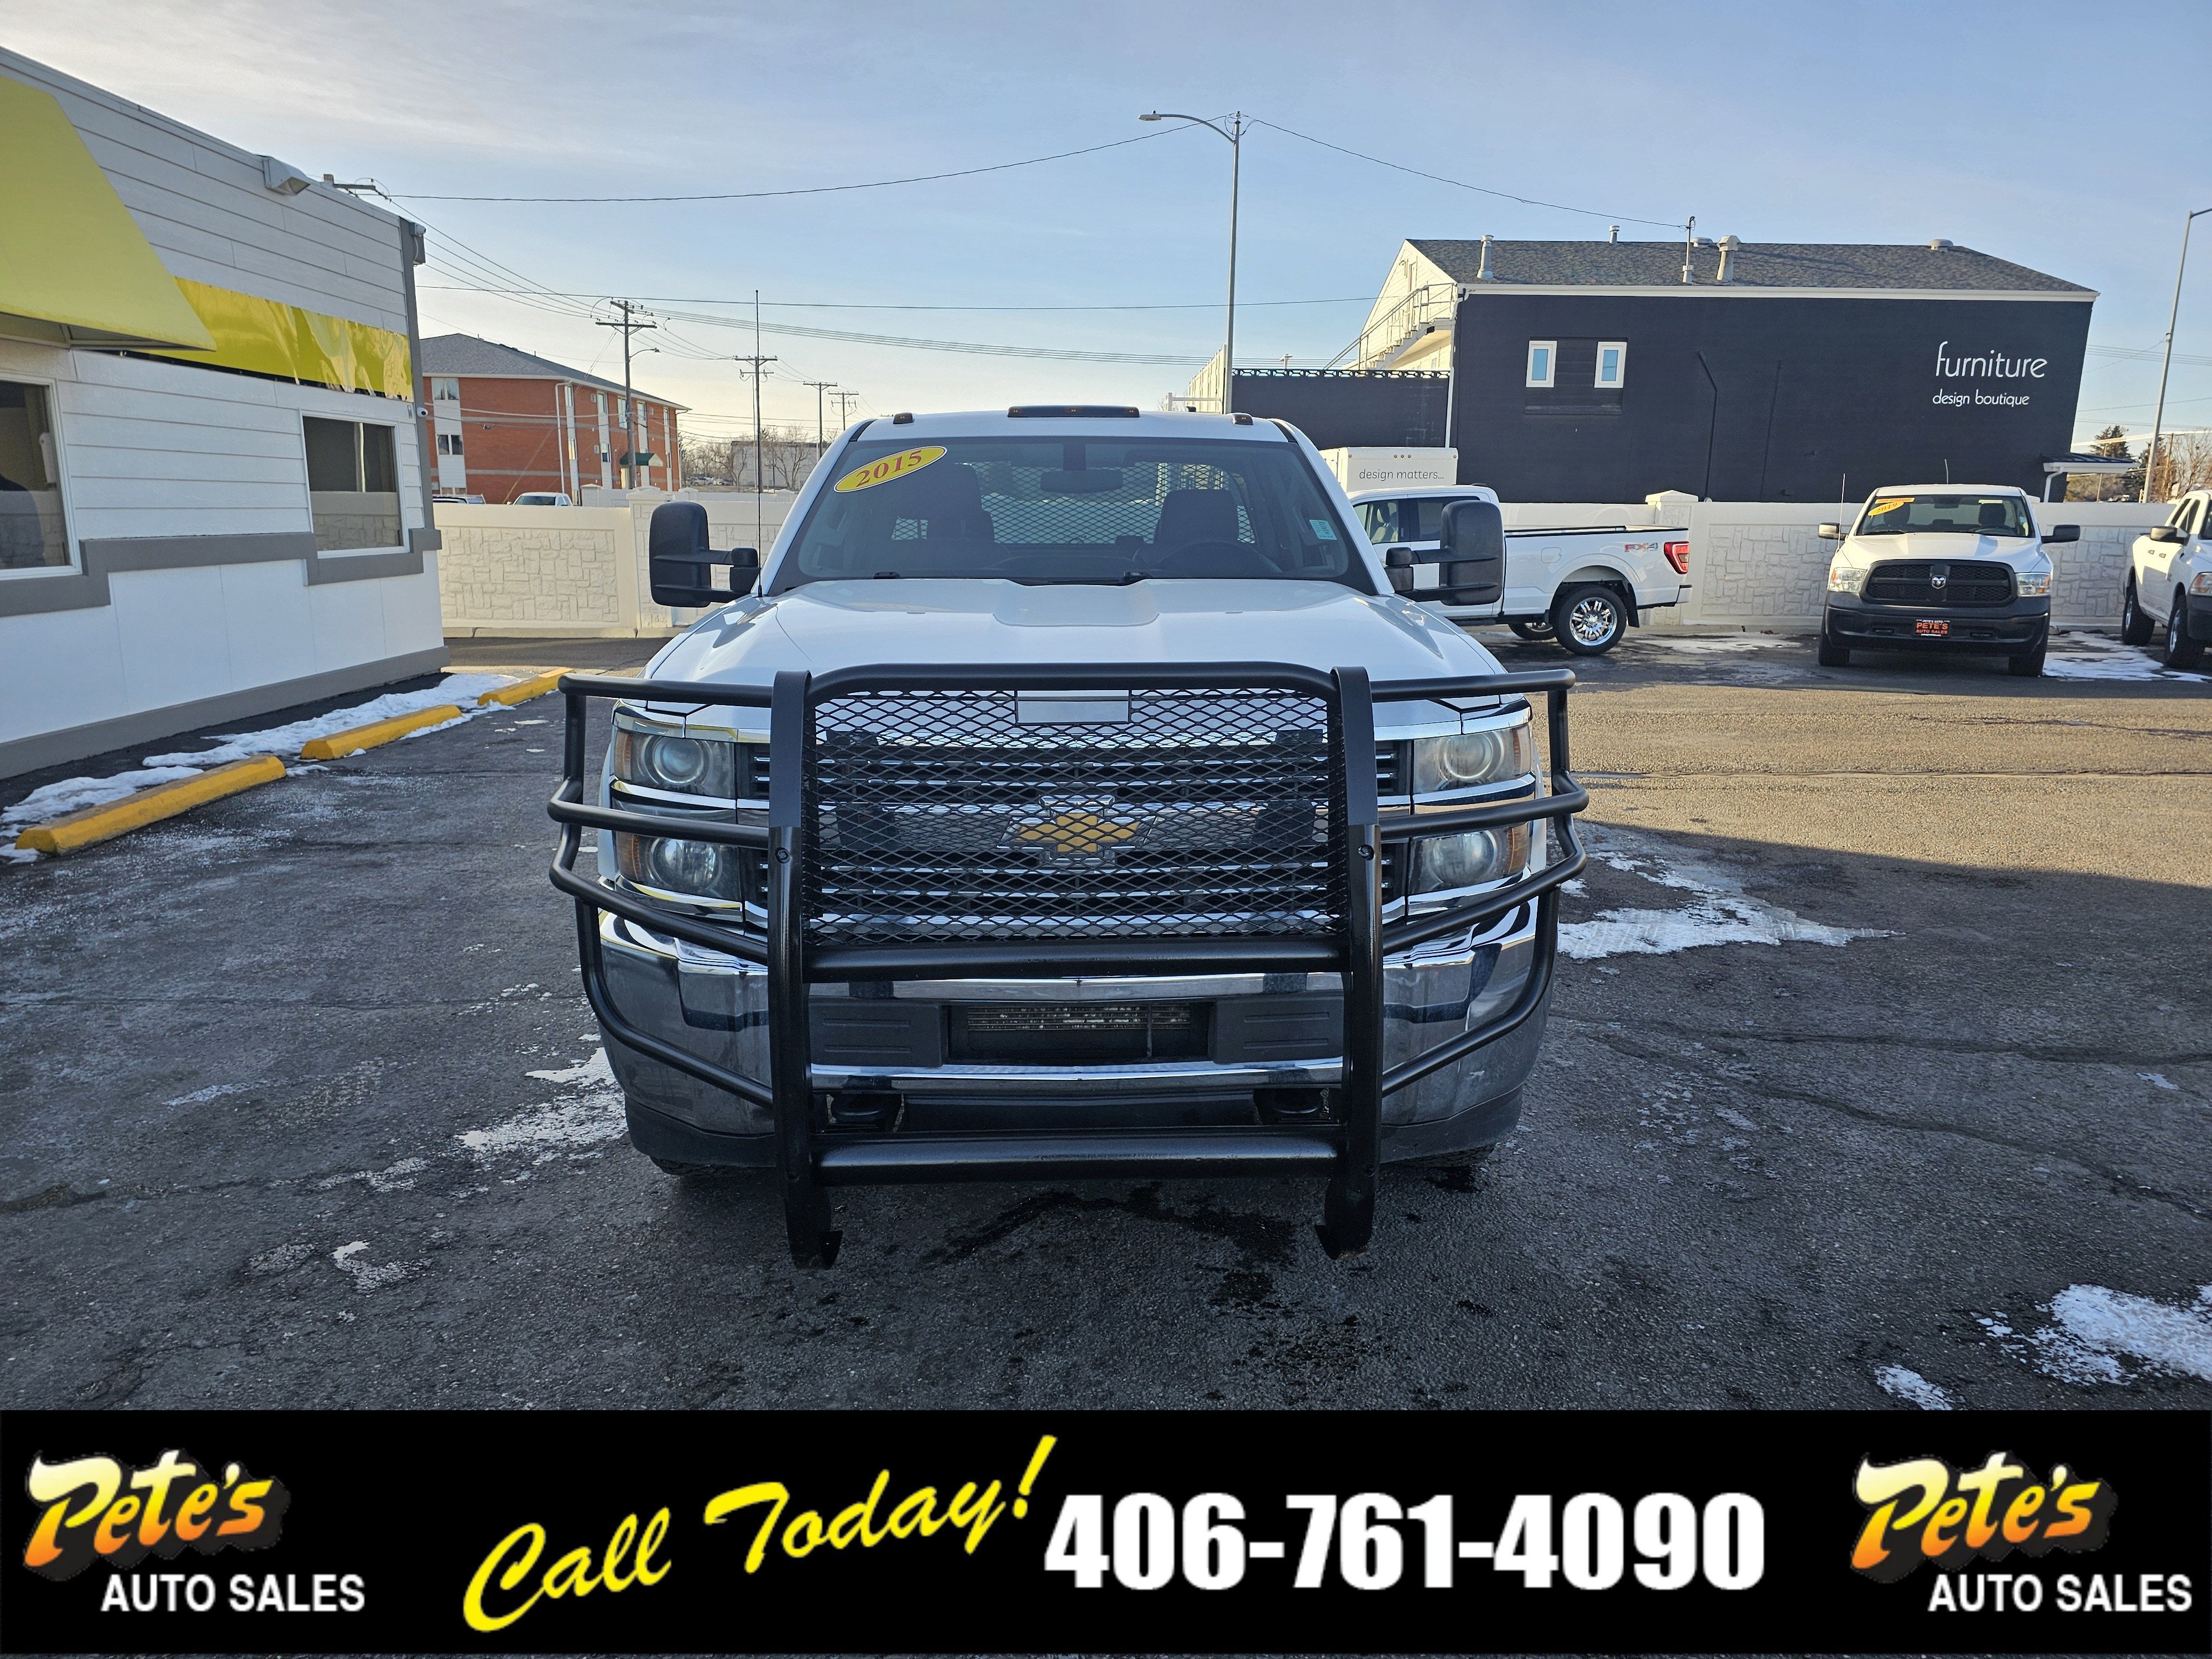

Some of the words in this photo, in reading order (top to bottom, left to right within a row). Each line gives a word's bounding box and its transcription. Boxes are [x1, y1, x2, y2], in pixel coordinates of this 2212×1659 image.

[1936, 341, 2048, 378] furniture
[1932, 389, 1970, 407] design
[1975, 389, 2030, 408] boutique
[855, 450, 922, 488] 2015
[1359, 469, 1393, 482] design
[1396, 471, 1444, 479] matters...
[1624, 542, 1658, 552] FX4
